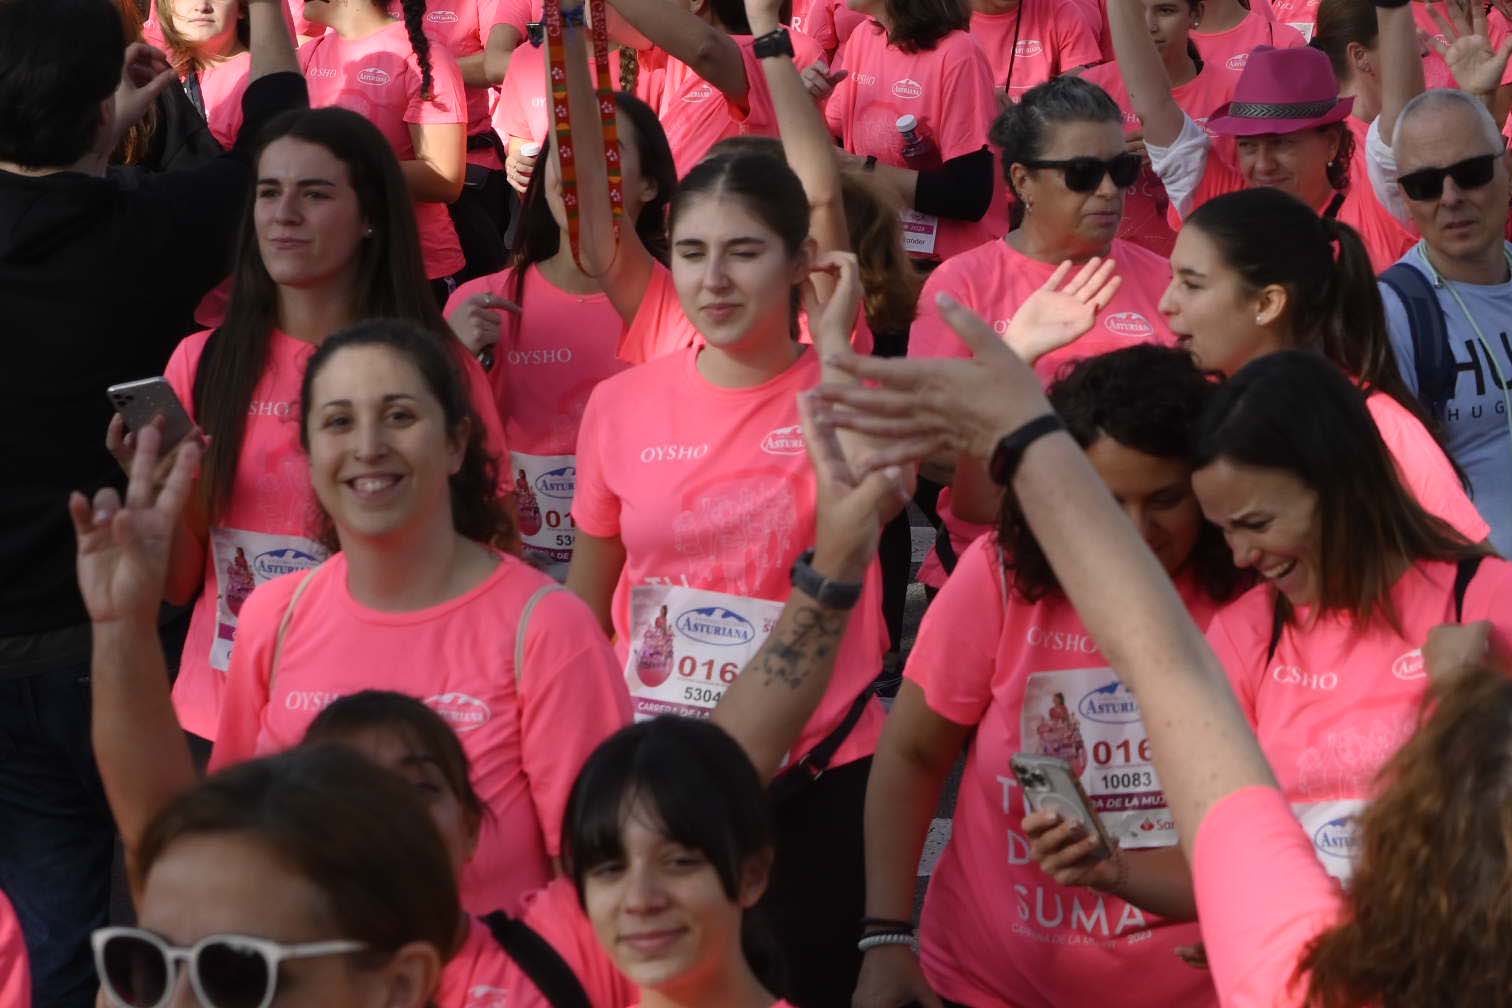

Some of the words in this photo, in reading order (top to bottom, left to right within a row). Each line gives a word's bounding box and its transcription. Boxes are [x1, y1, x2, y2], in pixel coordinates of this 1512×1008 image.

[508, 347, 573, 364] OYSHO
[640, 443, 710, 464] OYSHO
[555, 534, 576, 546] 53
[681, 616, 749, 641] ASTURIANA
[678, 655, 739, 684] 016
[684, 686, 721, 704] 5304
[1092, 738, 1152, 765] 016
[1101, 772, 1152, 789] 10083
[1105, 798, 1122, 808] DE
[1125, 796, 1140, 807] LA
[1014, 883, 1147, 936] SUMA
